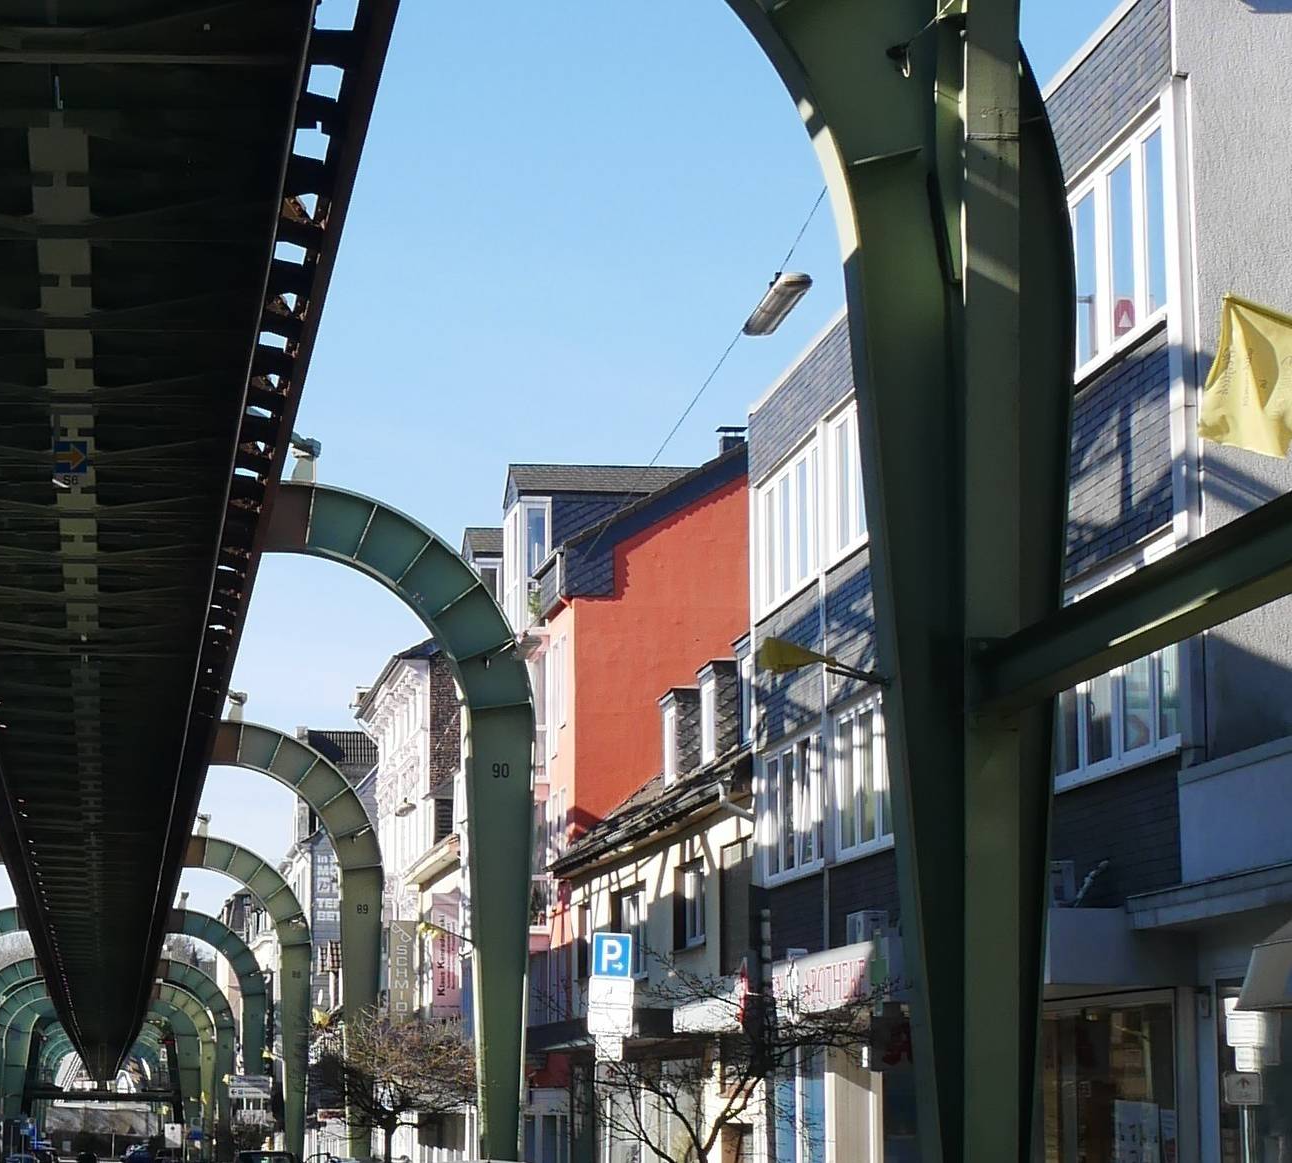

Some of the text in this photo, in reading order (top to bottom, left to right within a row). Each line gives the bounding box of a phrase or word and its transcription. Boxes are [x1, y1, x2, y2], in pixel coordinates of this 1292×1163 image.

[492, 762, 510, 778] 90
[356, 904, 369, 915] 89
[601, 939, 623, 973] P
[395, 944, 409, 1023] SCHMIDT
